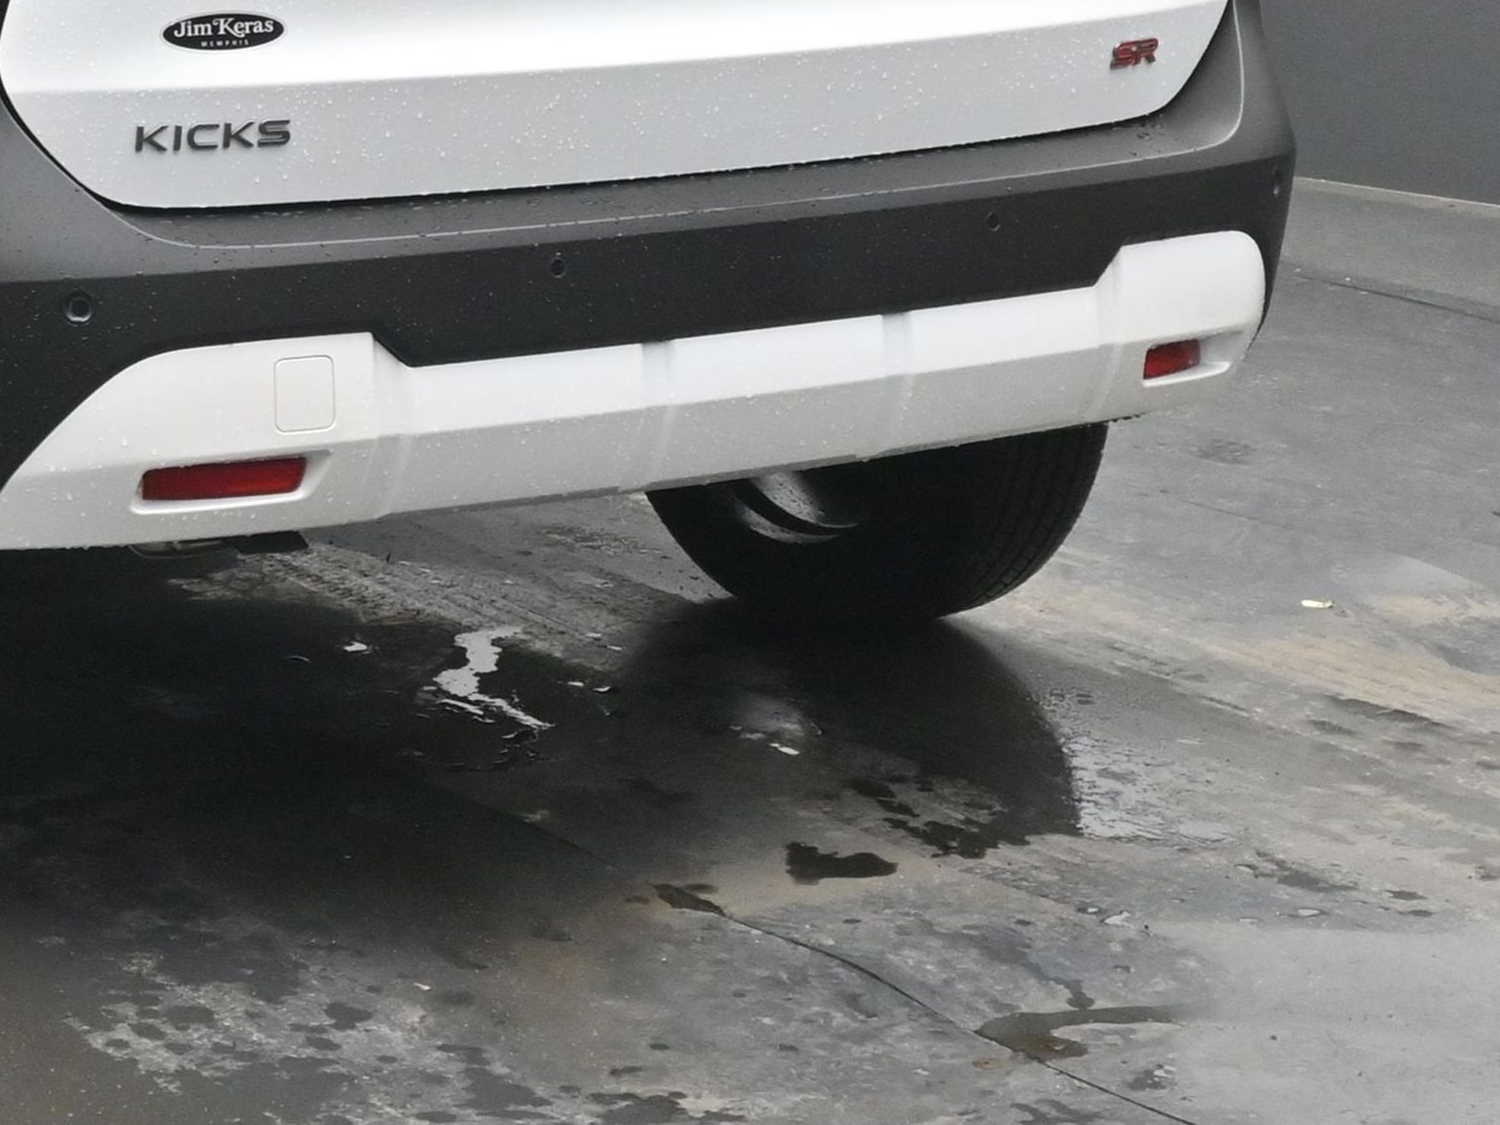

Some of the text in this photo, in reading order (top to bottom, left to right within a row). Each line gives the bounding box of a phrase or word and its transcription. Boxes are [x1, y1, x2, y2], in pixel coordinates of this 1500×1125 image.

[201, 39, 249, 47] MEMPHIS
[1109, 37, 1159, 70] SR
[134, 119, 292, 153] KICKS
